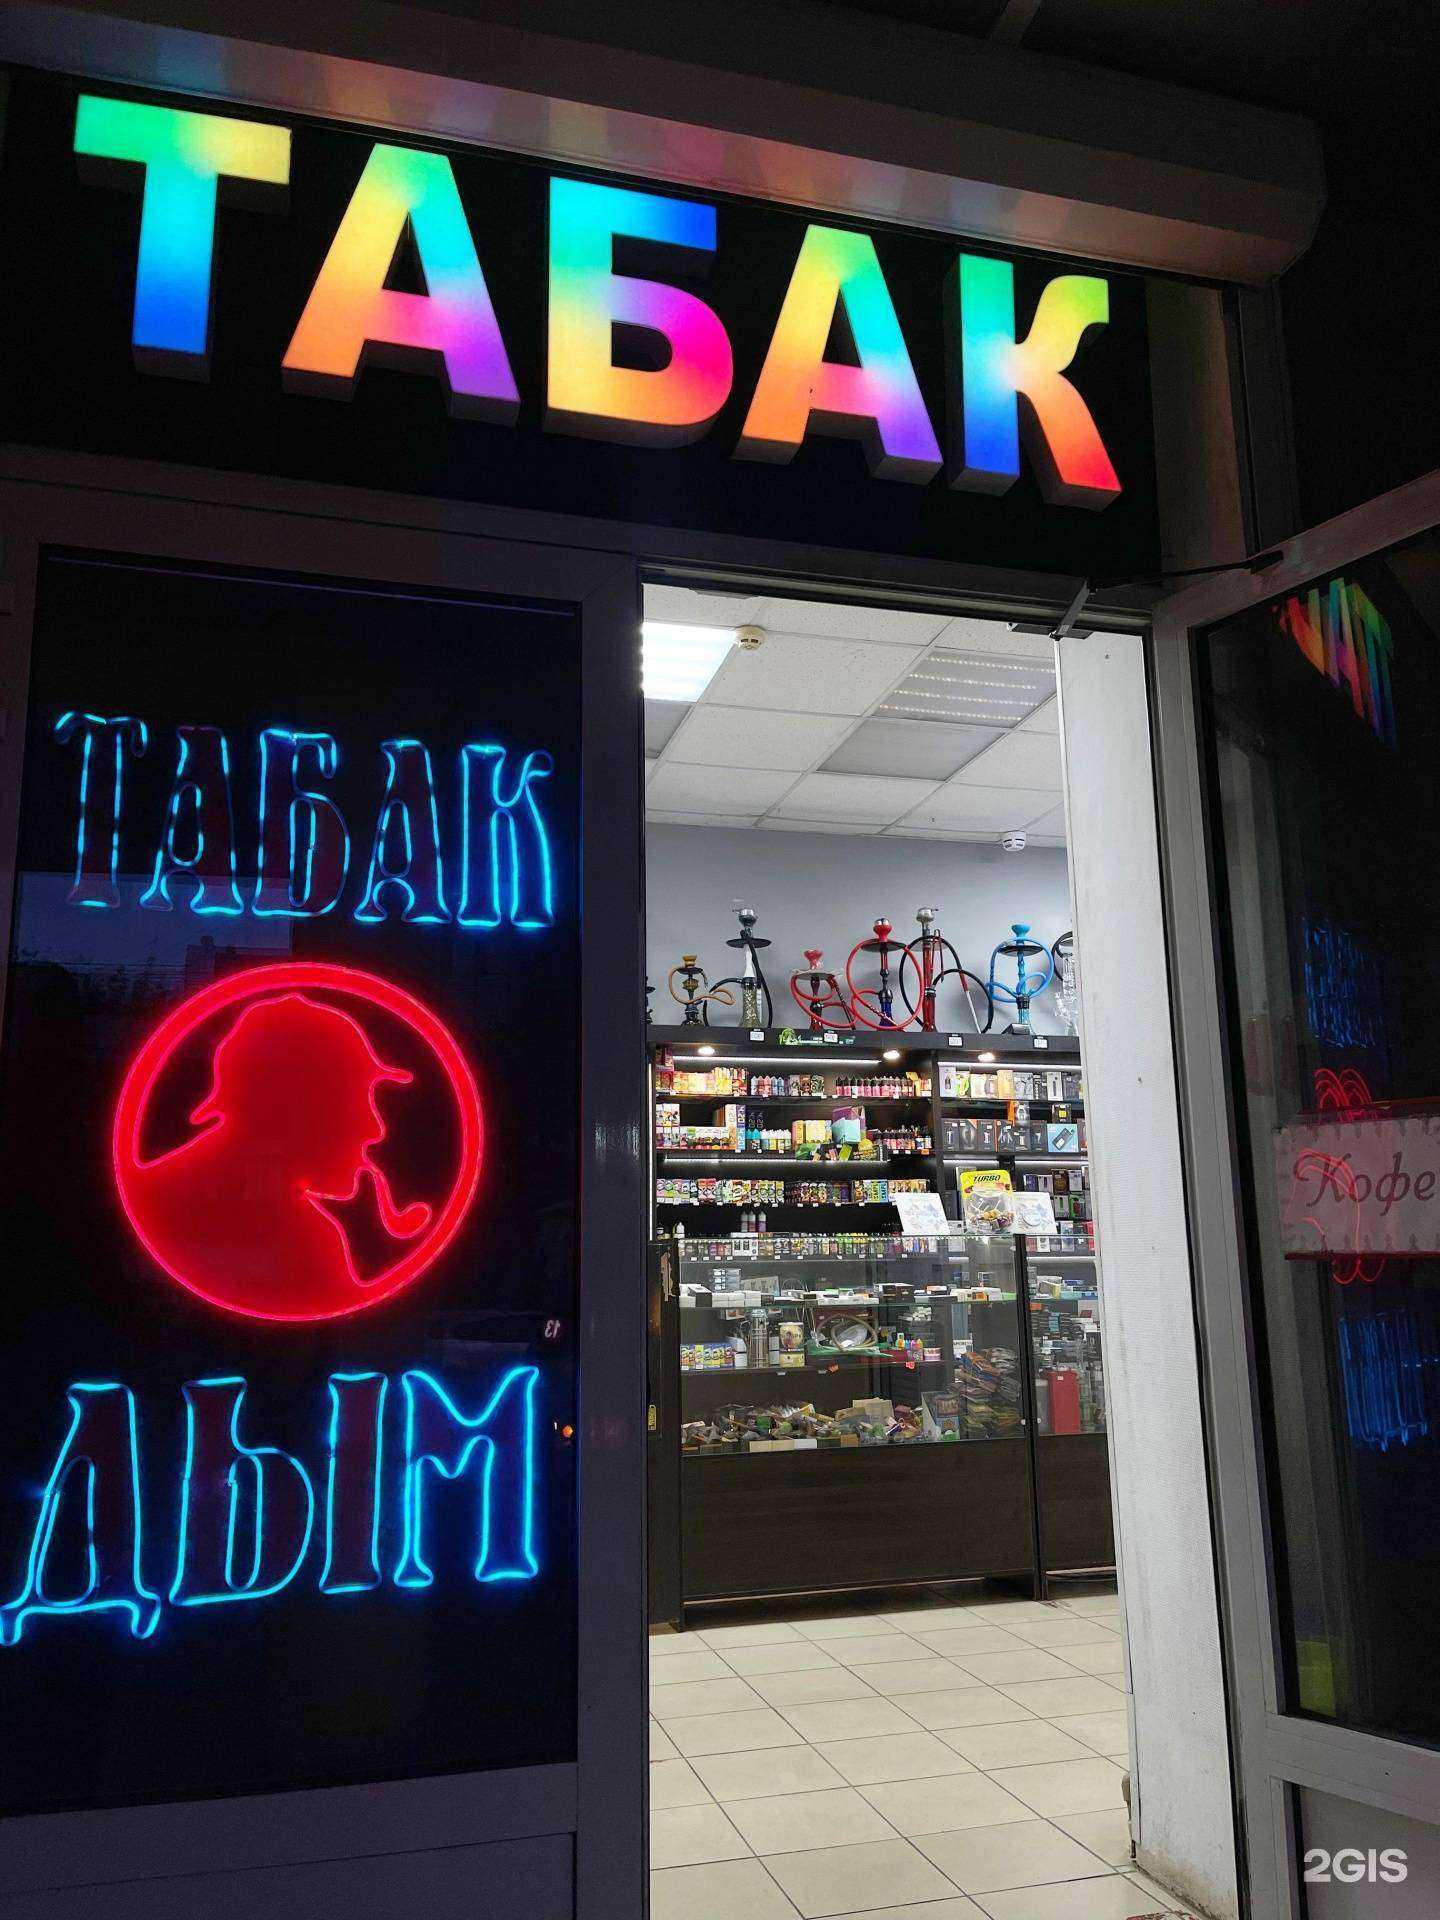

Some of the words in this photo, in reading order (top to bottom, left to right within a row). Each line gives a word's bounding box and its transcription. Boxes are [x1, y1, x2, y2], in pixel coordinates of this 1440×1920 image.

[73, 94, 1122, 495] ТАБАК
[55, 711, 555, 927] ТАБАК
[1294, 1151, 1436, 1216] Кофе
[0, 1366, 541, 1646] ДЫМ
